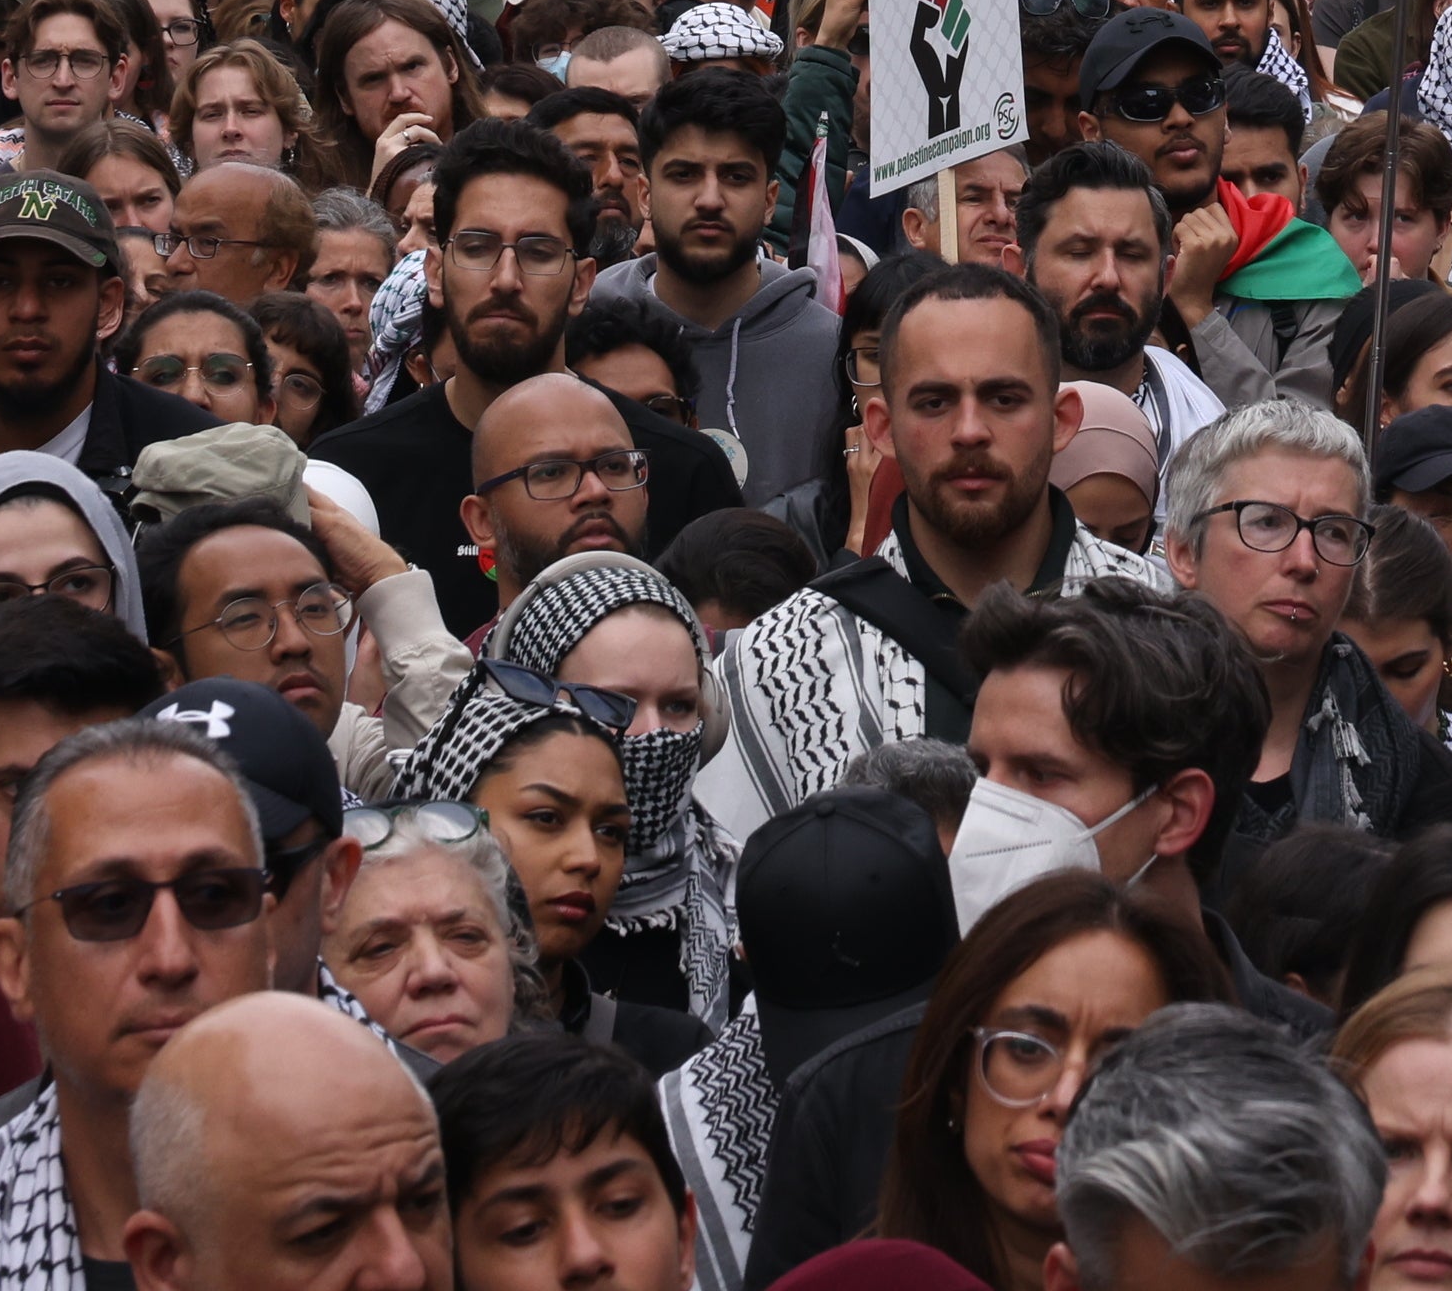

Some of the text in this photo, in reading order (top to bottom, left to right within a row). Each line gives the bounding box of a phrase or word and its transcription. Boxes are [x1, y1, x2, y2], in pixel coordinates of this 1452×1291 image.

[874, 123, 990, 182] www.palestinecampaign.org
[18, 191, 55, 221] N
[43, 181, 97, 227] STARS
[457, 545, 479, 556] Still
